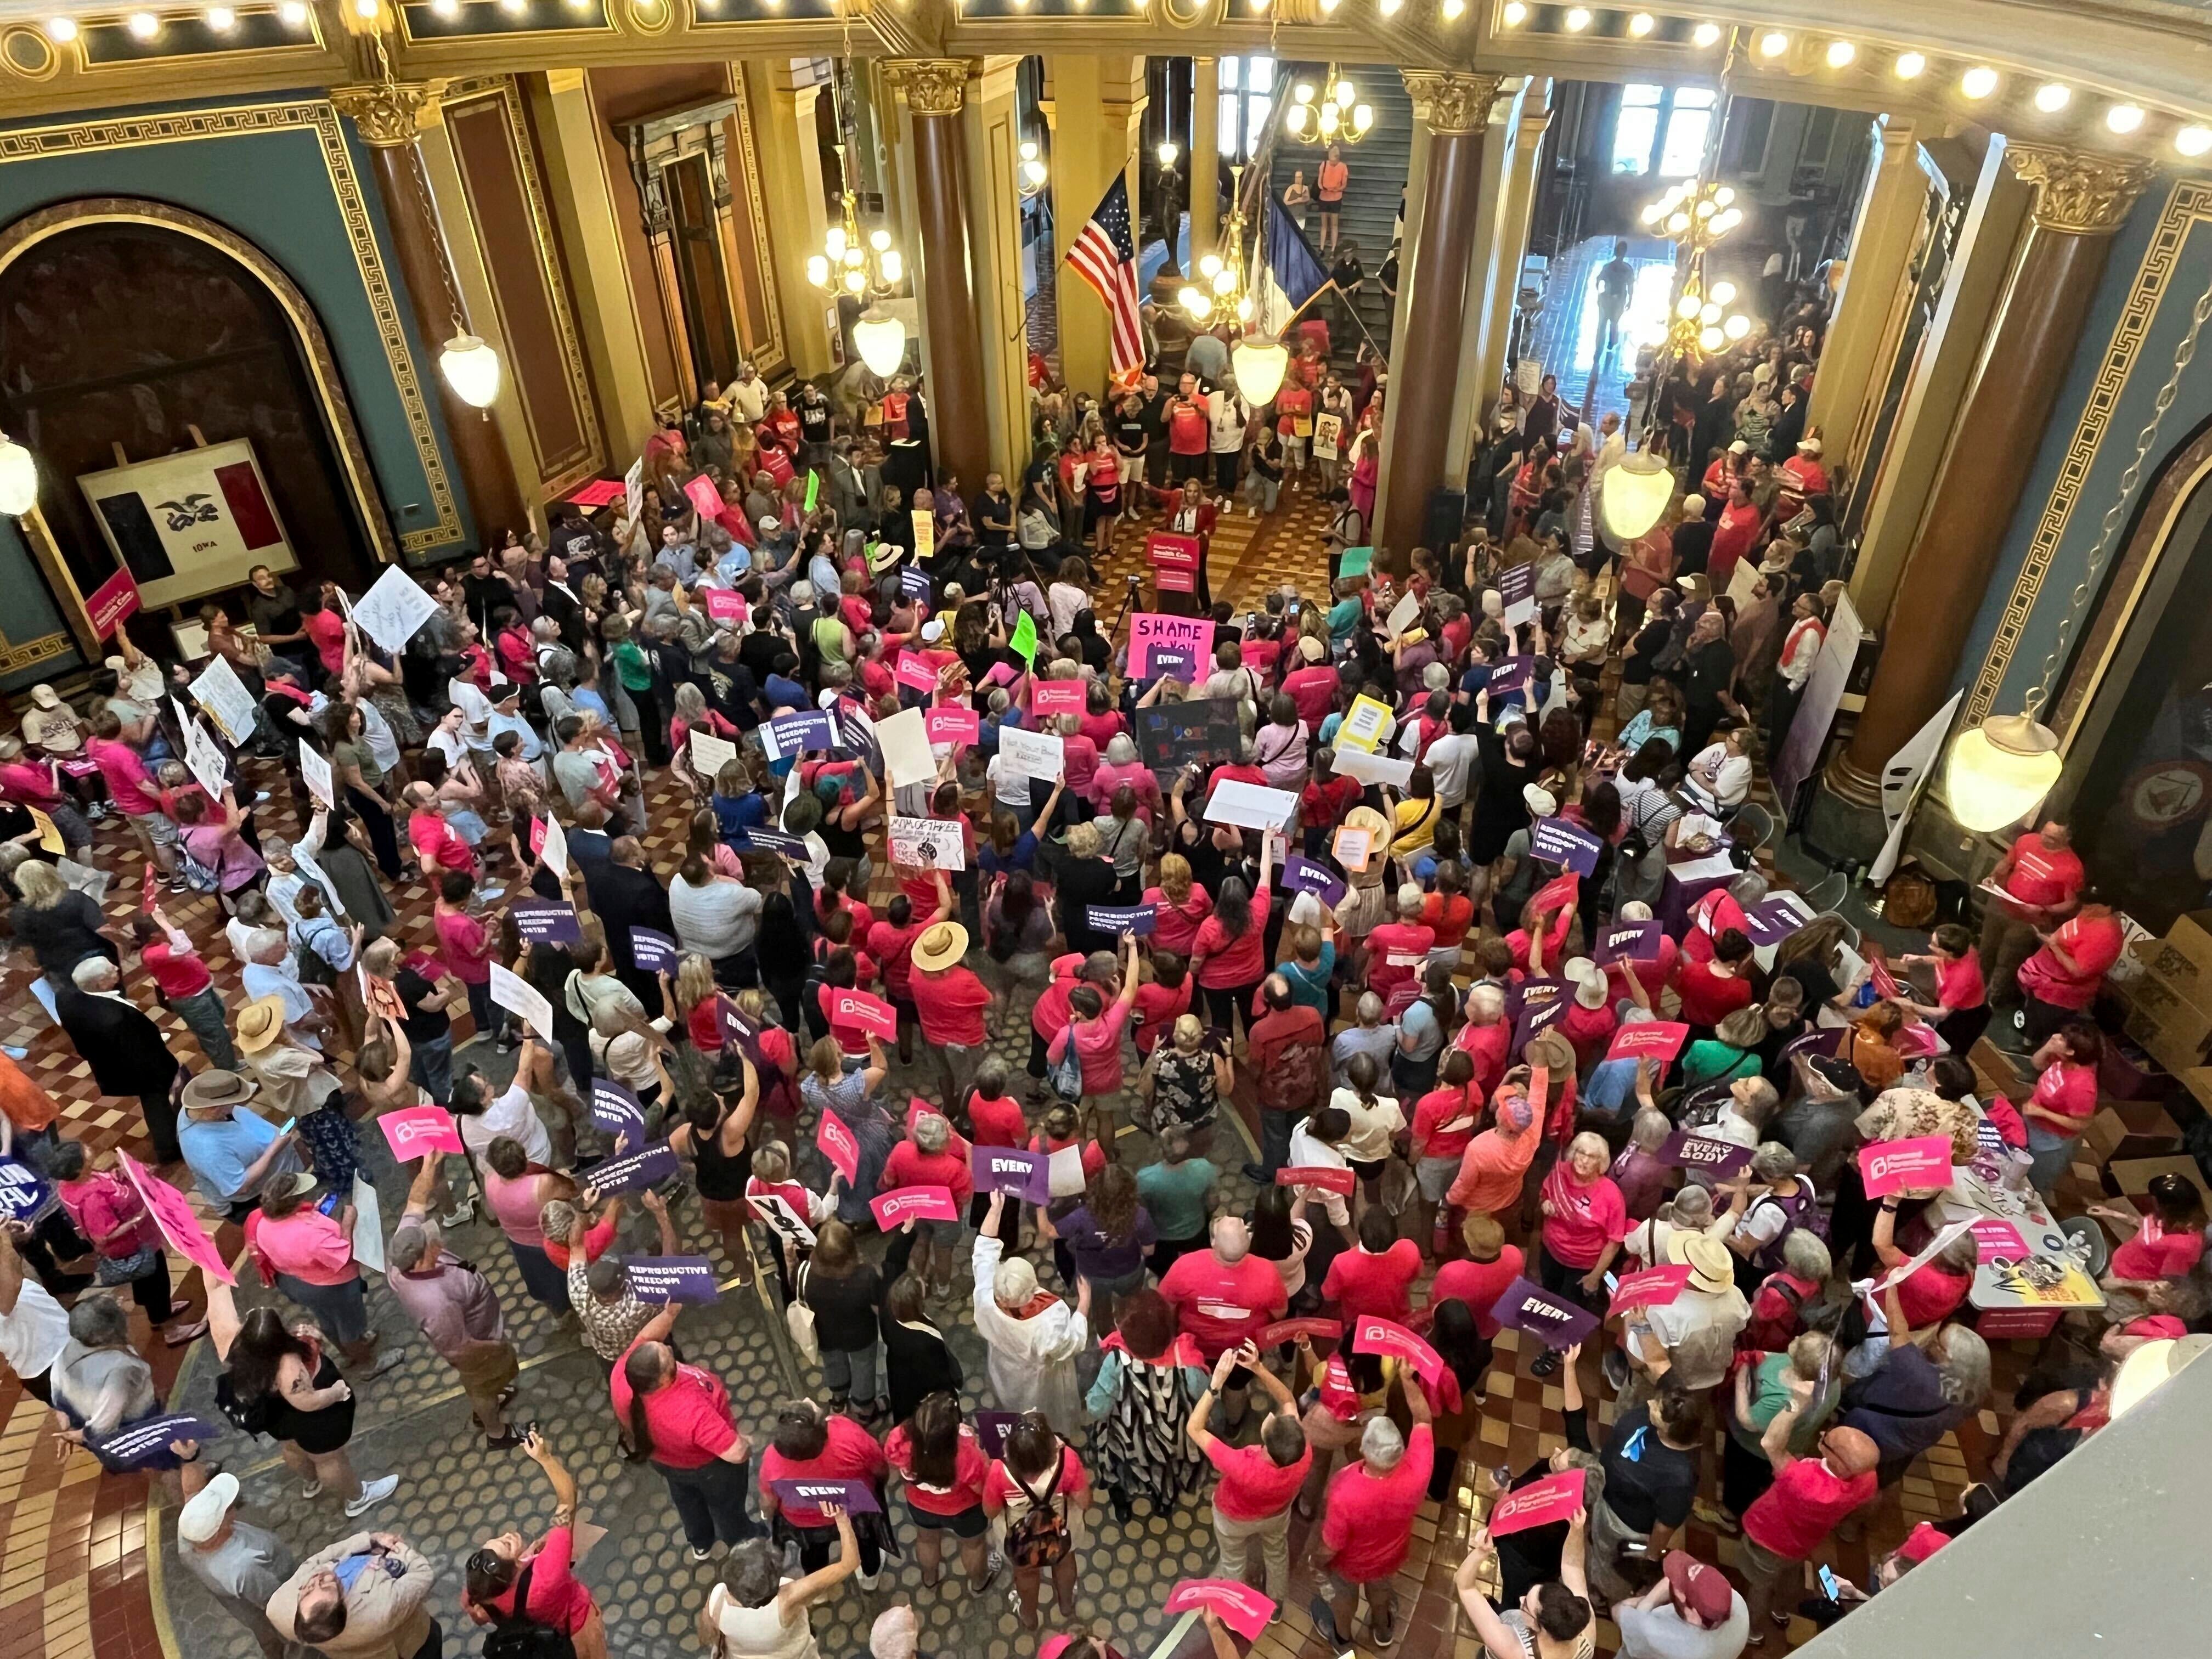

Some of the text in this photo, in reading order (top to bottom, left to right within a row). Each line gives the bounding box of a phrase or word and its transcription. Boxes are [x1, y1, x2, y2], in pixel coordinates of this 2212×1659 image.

[193, 541, 218, 552] IOWA
[1138, 620, 1202, 640] SHAME
[1682, 1141, 1734, 1154] EVERY
[1679, 1151, 1729, 1164] BODY
[991, 1158, 1034, 1173] EVERY
[628, 1265, 708, 1275] REPRODUCTIVE
[632, 1275, 680, 1284] FREEDOM
[635, 1284, 669, 1295] VOTER
[1521, 1296, 1573, 1322] EVERY
